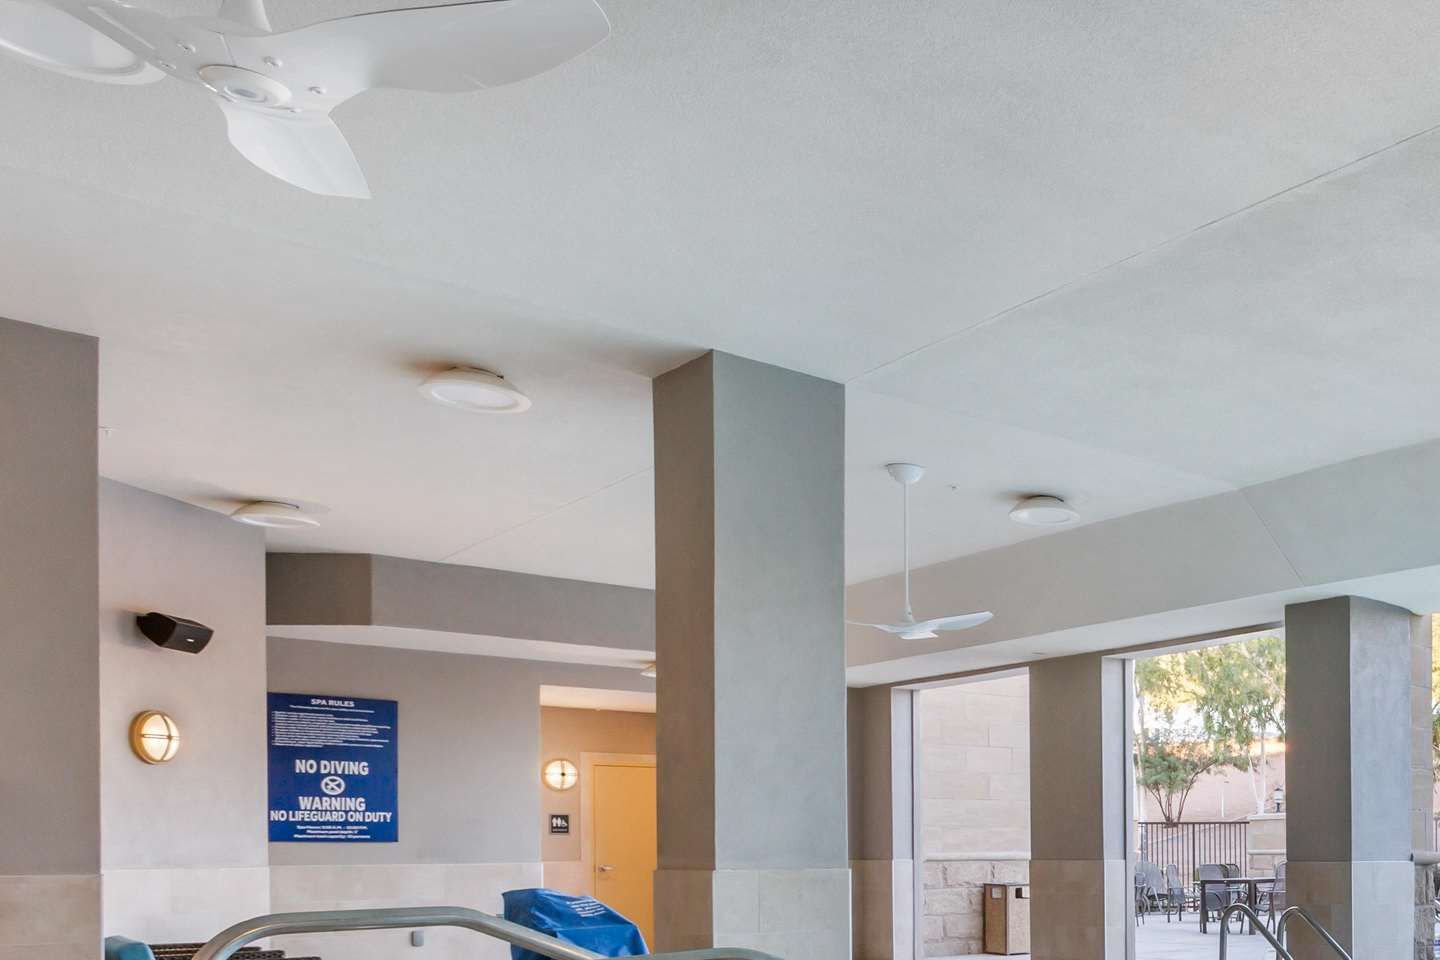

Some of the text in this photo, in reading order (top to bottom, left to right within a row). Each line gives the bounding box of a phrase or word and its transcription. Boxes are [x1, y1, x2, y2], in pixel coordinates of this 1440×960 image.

[328, 699, 354, 707] RULES
[295, 759, 369, 776] NO DIVING
[298, 796, 366, 811] WARNING
[270, 810, 392, 823] NO LIFEGUARD ON DUTY
